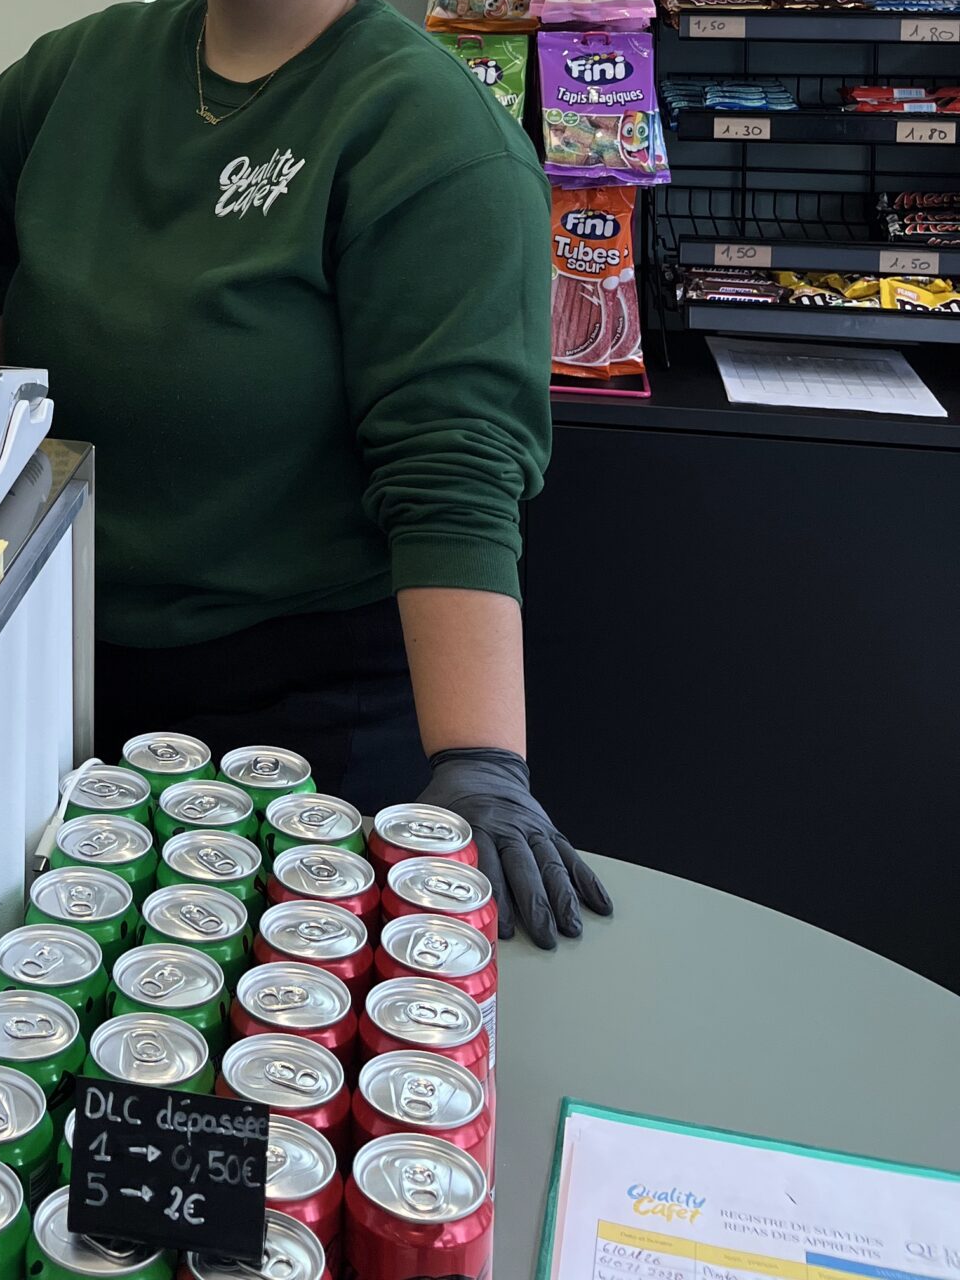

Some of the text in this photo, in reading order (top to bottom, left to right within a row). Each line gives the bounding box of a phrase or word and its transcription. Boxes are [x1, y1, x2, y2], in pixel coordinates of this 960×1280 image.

[694, 21, 725, 34] 1,50
[569, 55, 626, 82] Fini
[558, 87, 587, 105] Tapis
[218, 148, 306, 193] Quality
[214, 177, 290, 219] Cafet
[565, 213, 615, 238] Fini
[554, 236, 620, 264] Tubes
[567, 258, 606, 274] sour
[84, 1088, 142, 1127] DLC
[89, 1131, 112, 1163] 1
[84, 1173, 207, 1225] 5 2€
[627, 1183, 706, 1208] Quality
[633, 1196, 702, 1224] Cafet
